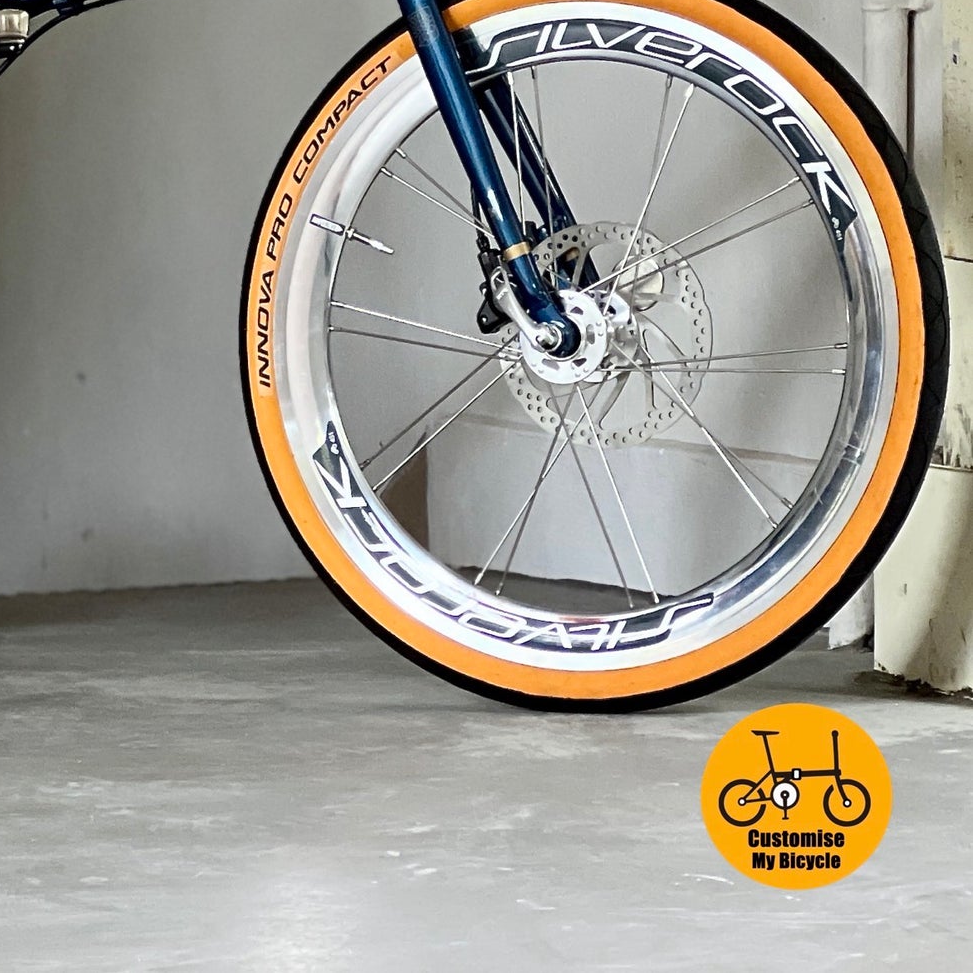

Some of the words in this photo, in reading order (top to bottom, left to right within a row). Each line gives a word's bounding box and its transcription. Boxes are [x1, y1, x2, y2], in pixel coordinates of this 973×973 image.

[257, 270, 275, 388] INNOVA
[266, 192, 293, 261] PRO
[292, 55, 392, 185] COMPACT
